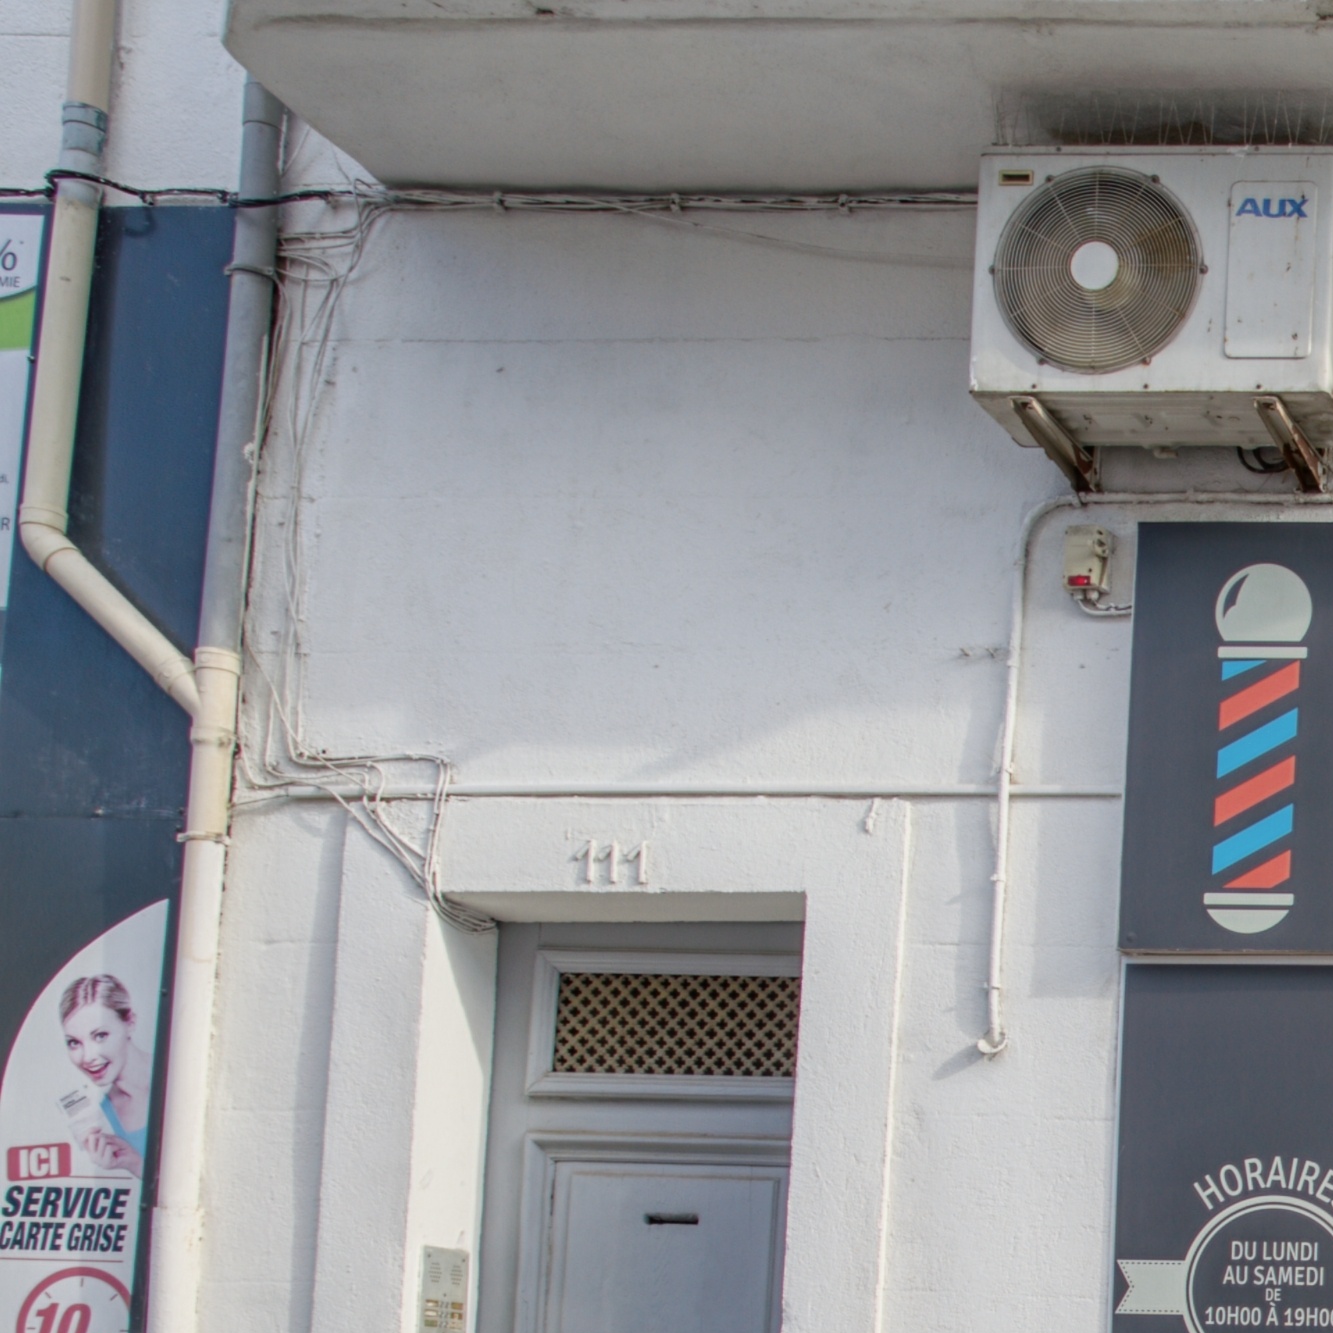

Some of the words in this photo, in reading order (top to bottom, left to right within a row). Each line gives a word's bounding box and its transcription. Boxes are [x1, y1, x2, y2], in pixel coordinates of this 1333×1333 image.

[1235, 198, 1309, 218] AUX
[572, 839, 648, 885] 111
[19, 1146, 60, 1178] ICI
[1, 1185, 131, 1219] SERVICE
[0, 1221, 65, 1251] CARTE
[67, 1223, 128, 1252] GRISE
[1231, 1241, 1257, 1261] DU
[1262, 1241, 1318, 1261] LUNDI
[1222, 1265, 1248, 1285] AU
[1253, 1266, 1324, 1286] SAMEDI
[1265, 1288, 1281, 1301] DE
[1205, 1306, 1262, 1326] 10H00
[1266, 1302, 1279, 1326] À
